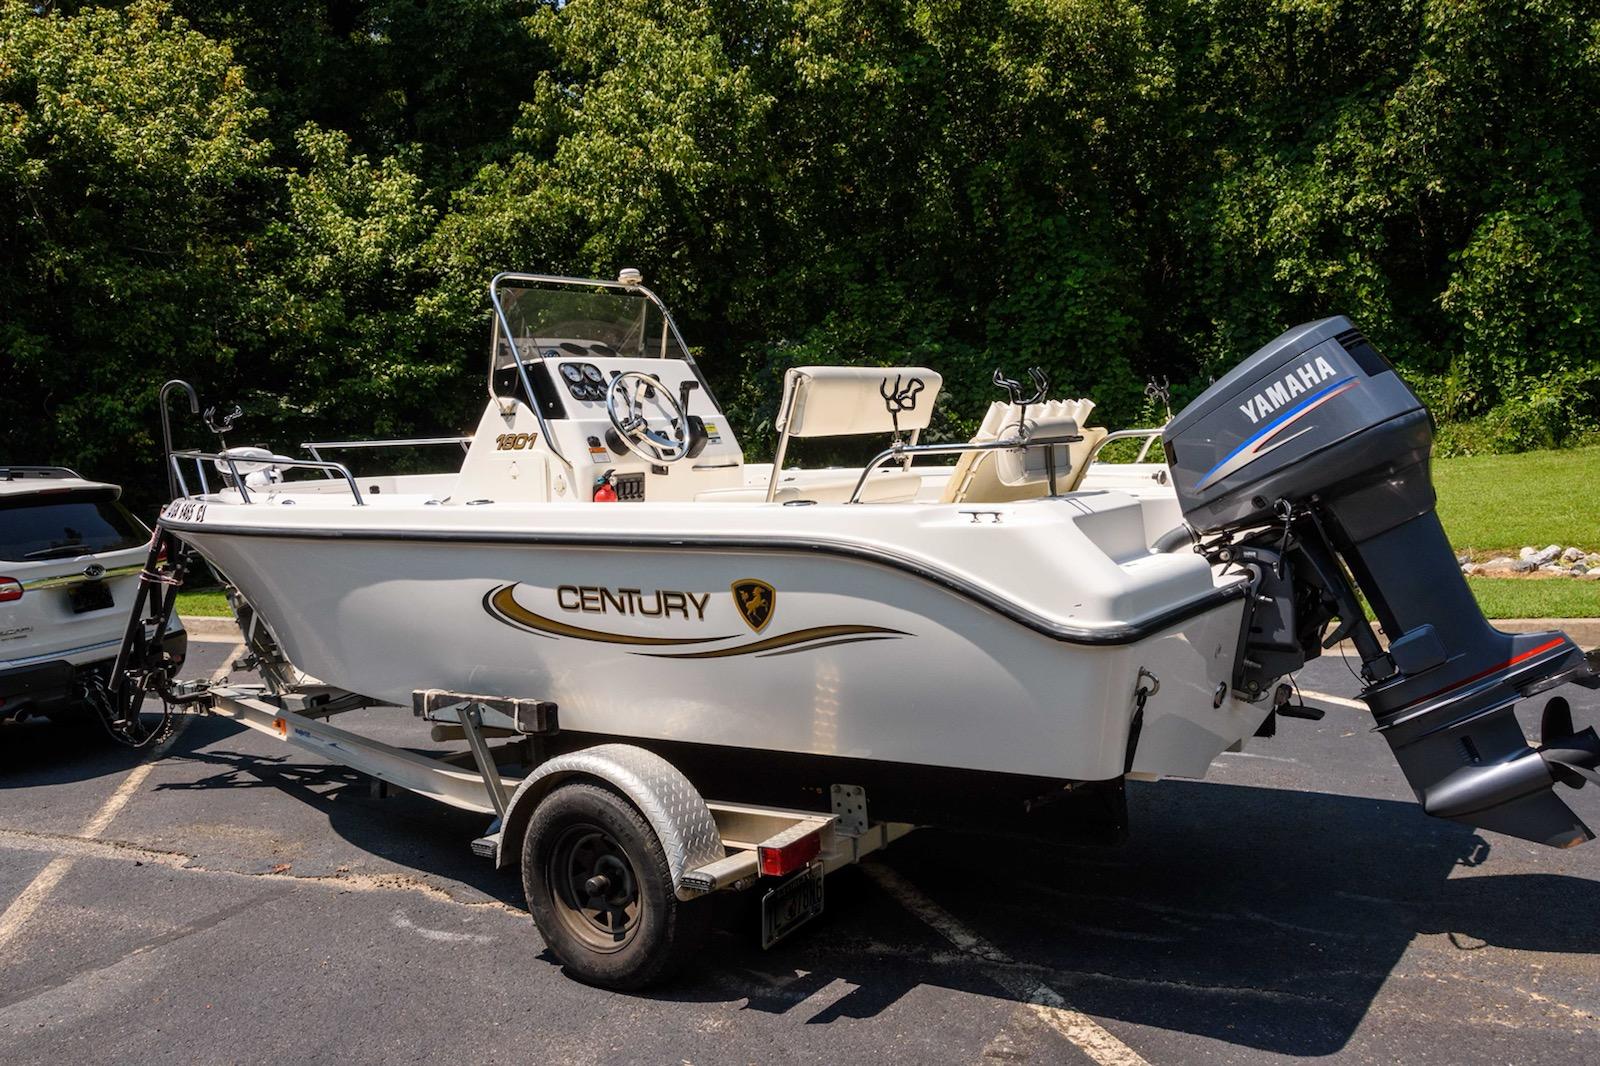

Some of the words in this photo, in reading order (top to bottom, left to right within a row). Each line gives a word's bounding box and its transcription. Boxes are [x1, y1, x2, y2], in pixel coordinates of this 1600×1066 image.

[1240, 356, 1337, 423] YAMAHA
[496, 433, 538, 450] 1801
[557, 585, 711, 621] CENTURY
